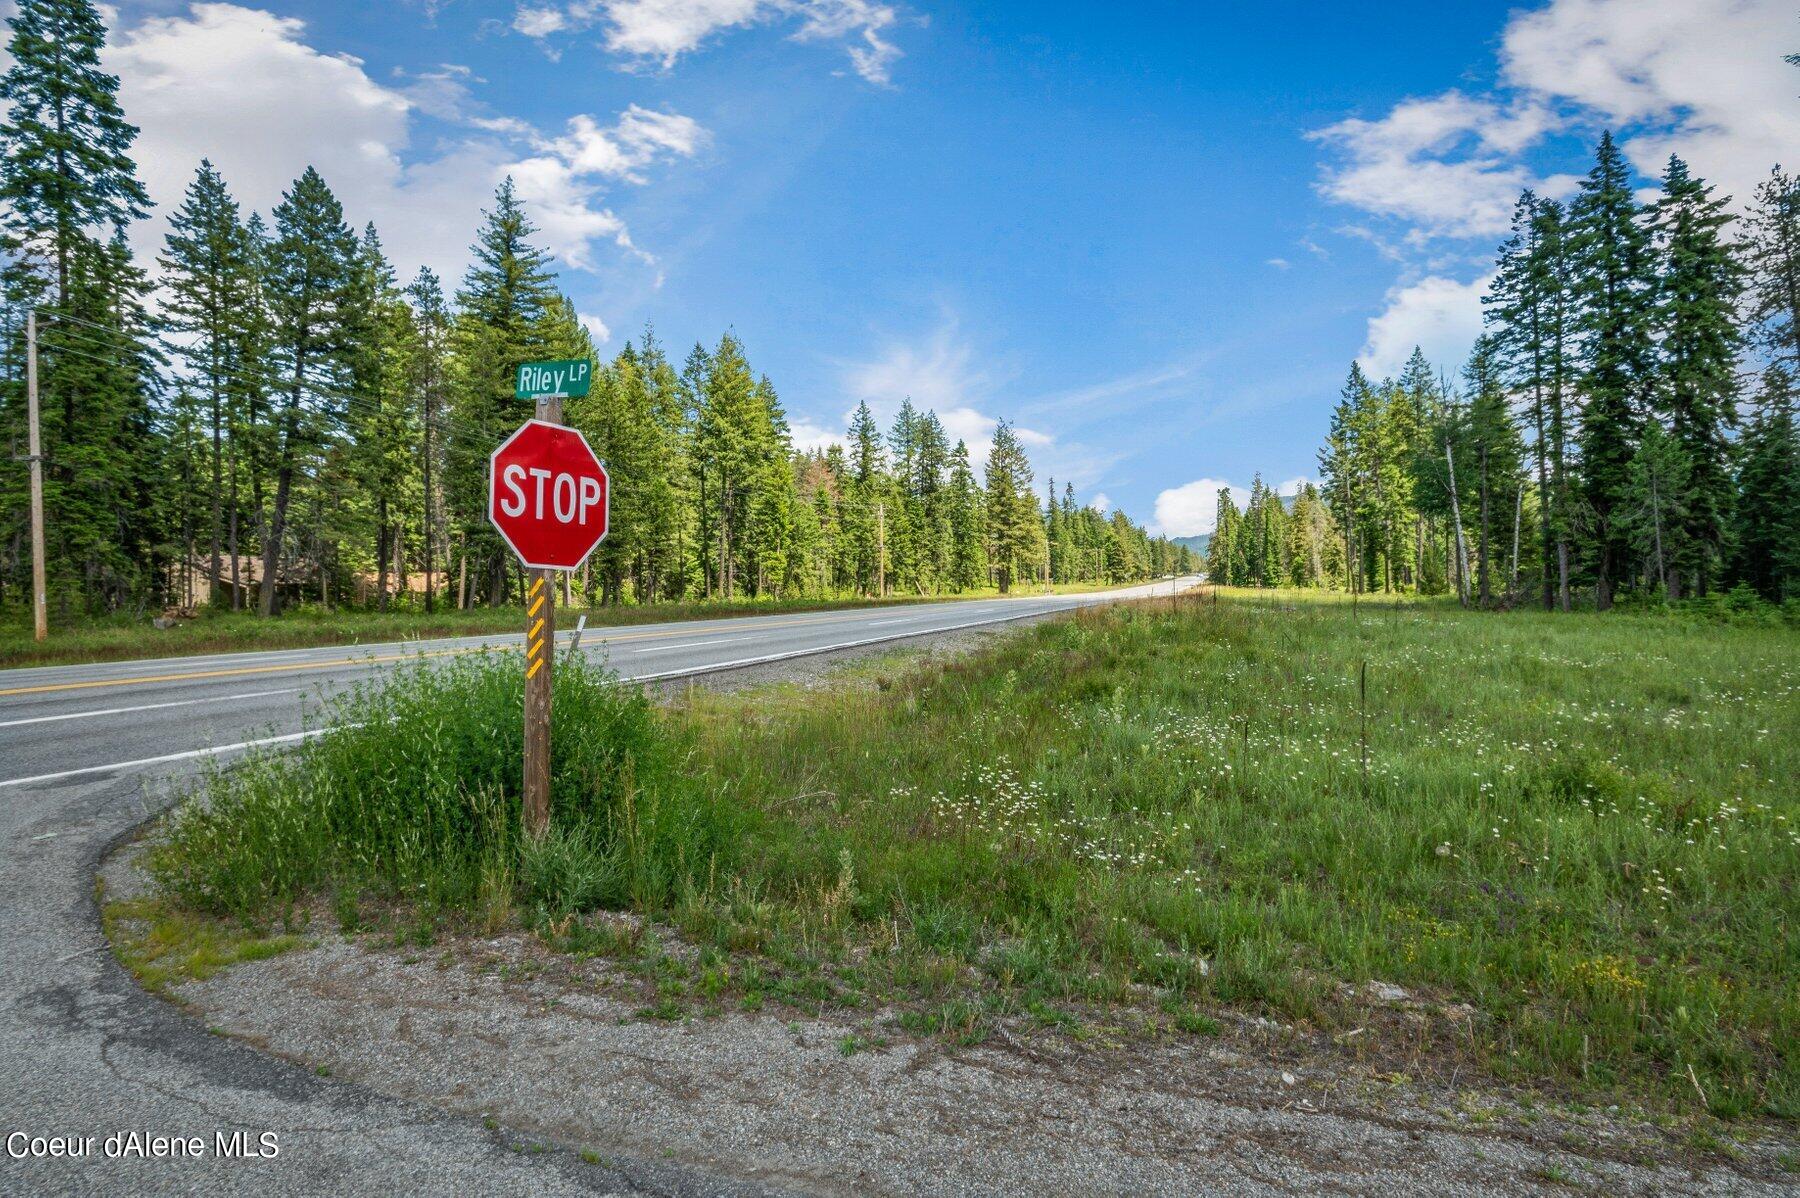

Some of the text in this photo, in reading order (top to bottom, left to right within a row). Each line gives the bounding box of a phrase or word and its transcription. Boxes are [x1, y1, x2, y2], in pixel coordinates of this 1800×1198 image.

[520, 363, 588, 393] Riley LP
[500, 464, 601, 525] STOP
